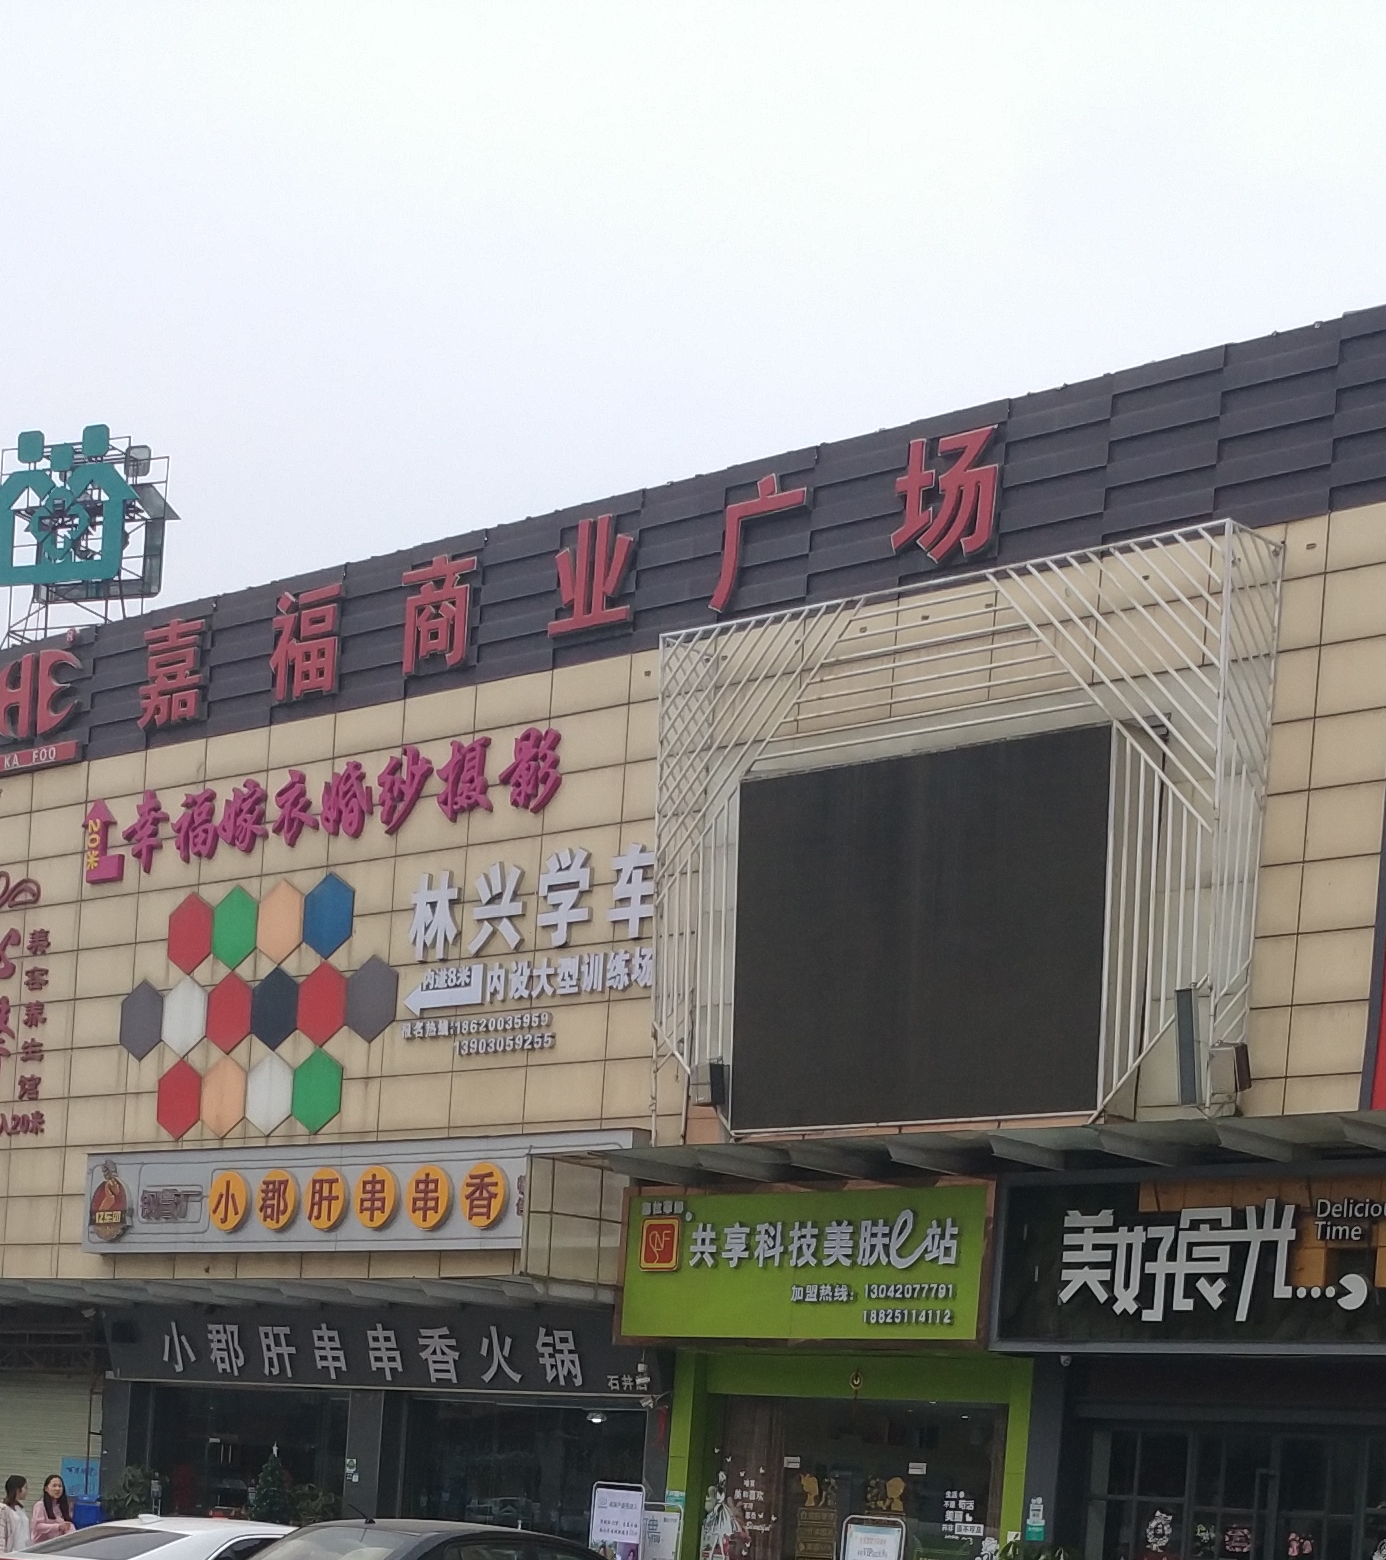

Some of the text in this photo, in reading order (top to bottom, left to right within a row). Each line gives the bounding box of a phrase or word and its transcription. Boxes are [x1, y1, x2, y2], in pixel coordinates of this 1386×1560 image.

[137, 425, 999, 730] 嘉福商业广场
[4, 747, 56, 769] KA FOO
[122, 727, 562, 873] 幸福嫁衣婚纱摄影
[408, 842, 656, 962] 林兴学车
[487, 946, 655, 1002] 内设大型训练场
[211, 1169, 500, 1226] 小郡肝串串香
[688, 1208, 960, 1270] 共享科技美肤e站
[1314, 1220, 1363, 1241] Time
[863, 1309, 952, 1325] 18825114112
[864, 1283, 954, 1300] 13042077791
[163, 1321, 583, 1388] 小郡肝串串香火锅
